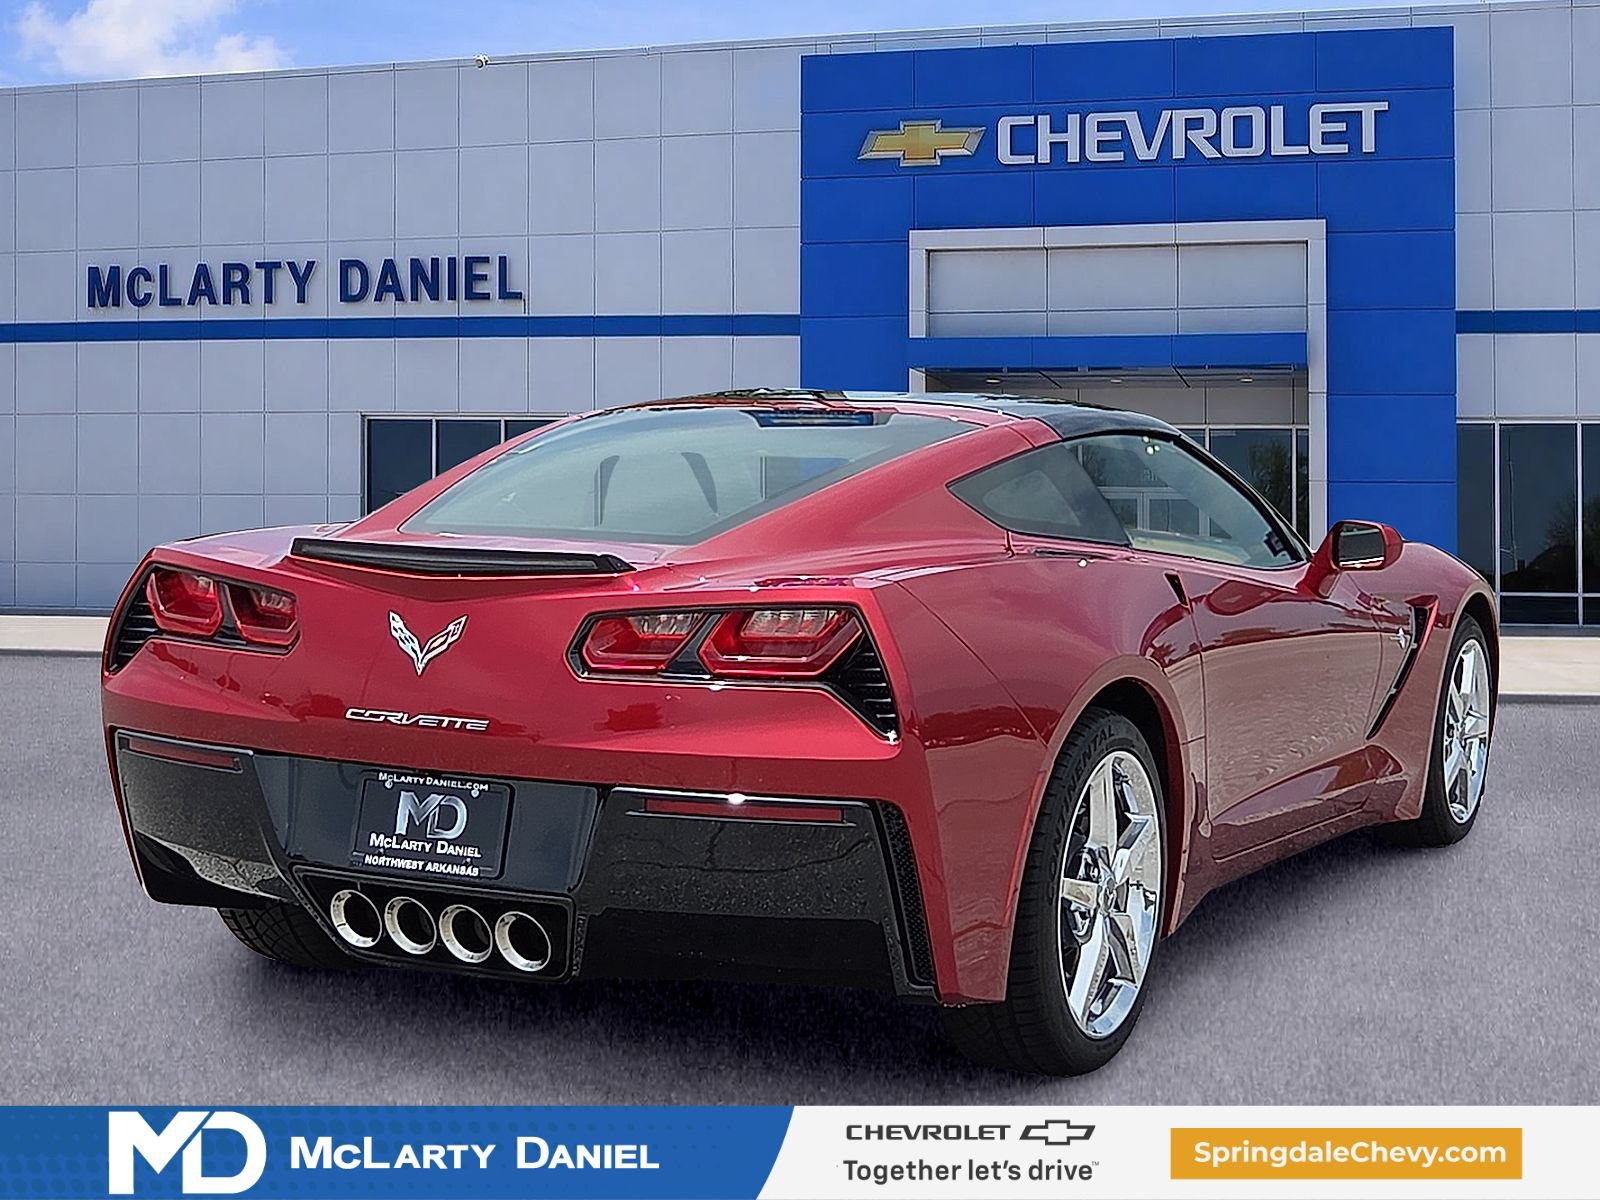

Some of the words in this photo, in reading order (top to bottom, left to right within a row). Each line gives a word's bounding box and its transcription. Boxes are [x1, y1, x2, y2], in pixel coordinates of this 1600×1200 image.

[996, 101, 1389, 165] CHEVROLET
[339, 256, 524, 303] DANIEL
[346, 708, 489, 731] CORVETTE
[395, 791, 468, 839] MD
[364, 854, 424, 871] NORTHWEST
[425, 861, 479, 877] ARKANSAS
[436, 841, 482, 858] DANIEL
